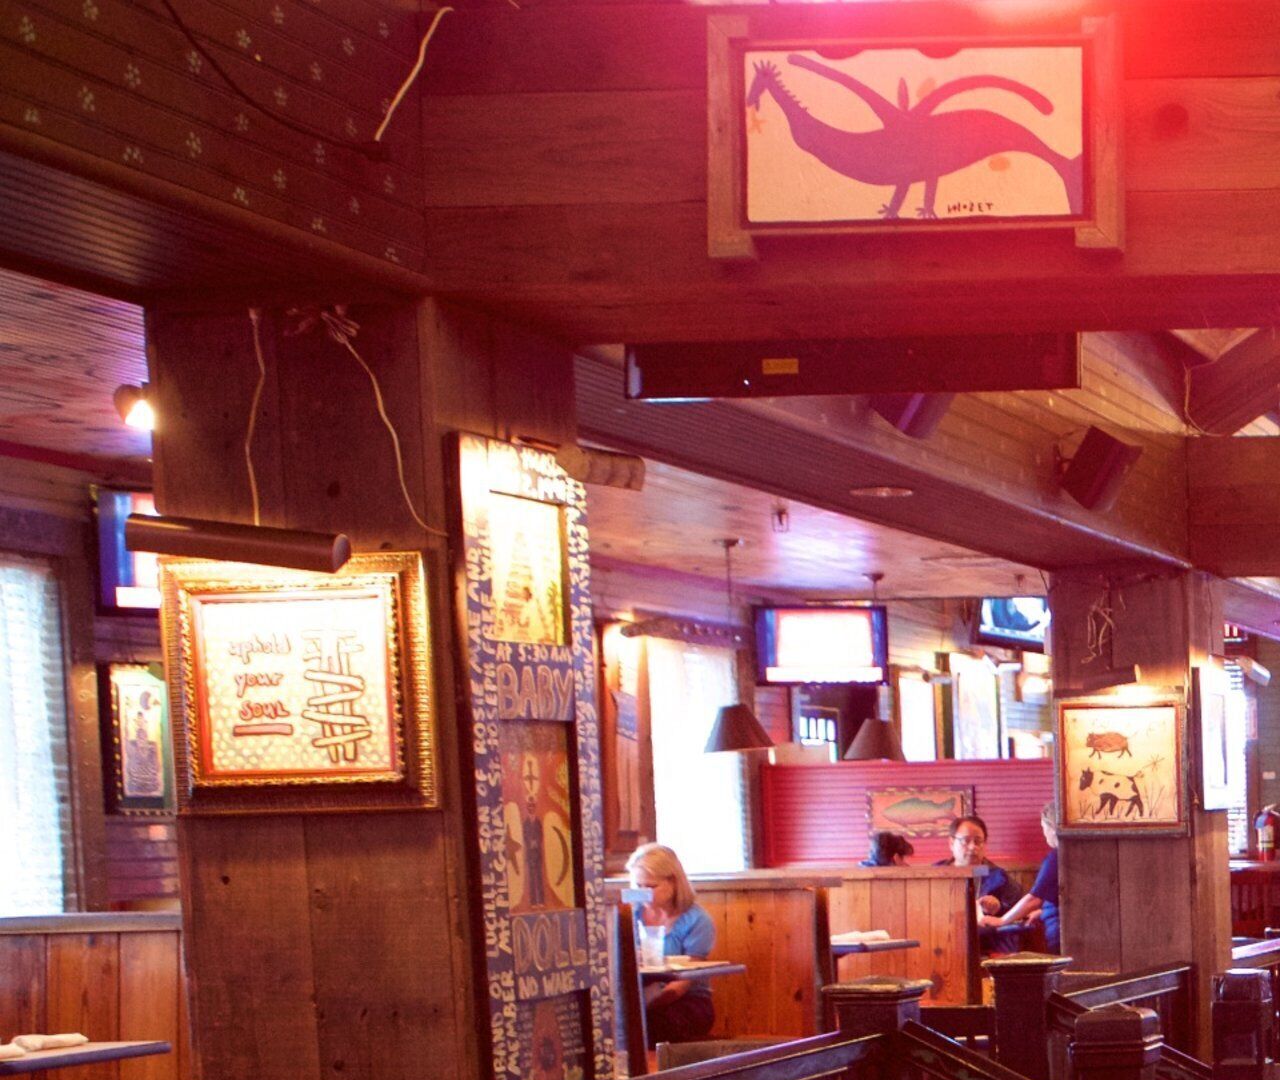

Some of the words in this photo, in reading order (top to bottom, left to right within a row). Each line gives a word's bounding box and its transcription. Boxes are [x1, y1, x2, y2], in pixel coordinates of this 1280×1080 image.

[234, 672, 285, 699] your
[496, 663, 574, 720] BABY
[474, 769, 488, 797] OF
[476, 806, 491, 853] SON
[512, 911, 588, 974] DOLL
[488, 971, 502, 999] OF
[518, 976, 539, 1000] NO
[500, 970, 521, 1076] MEMBER
